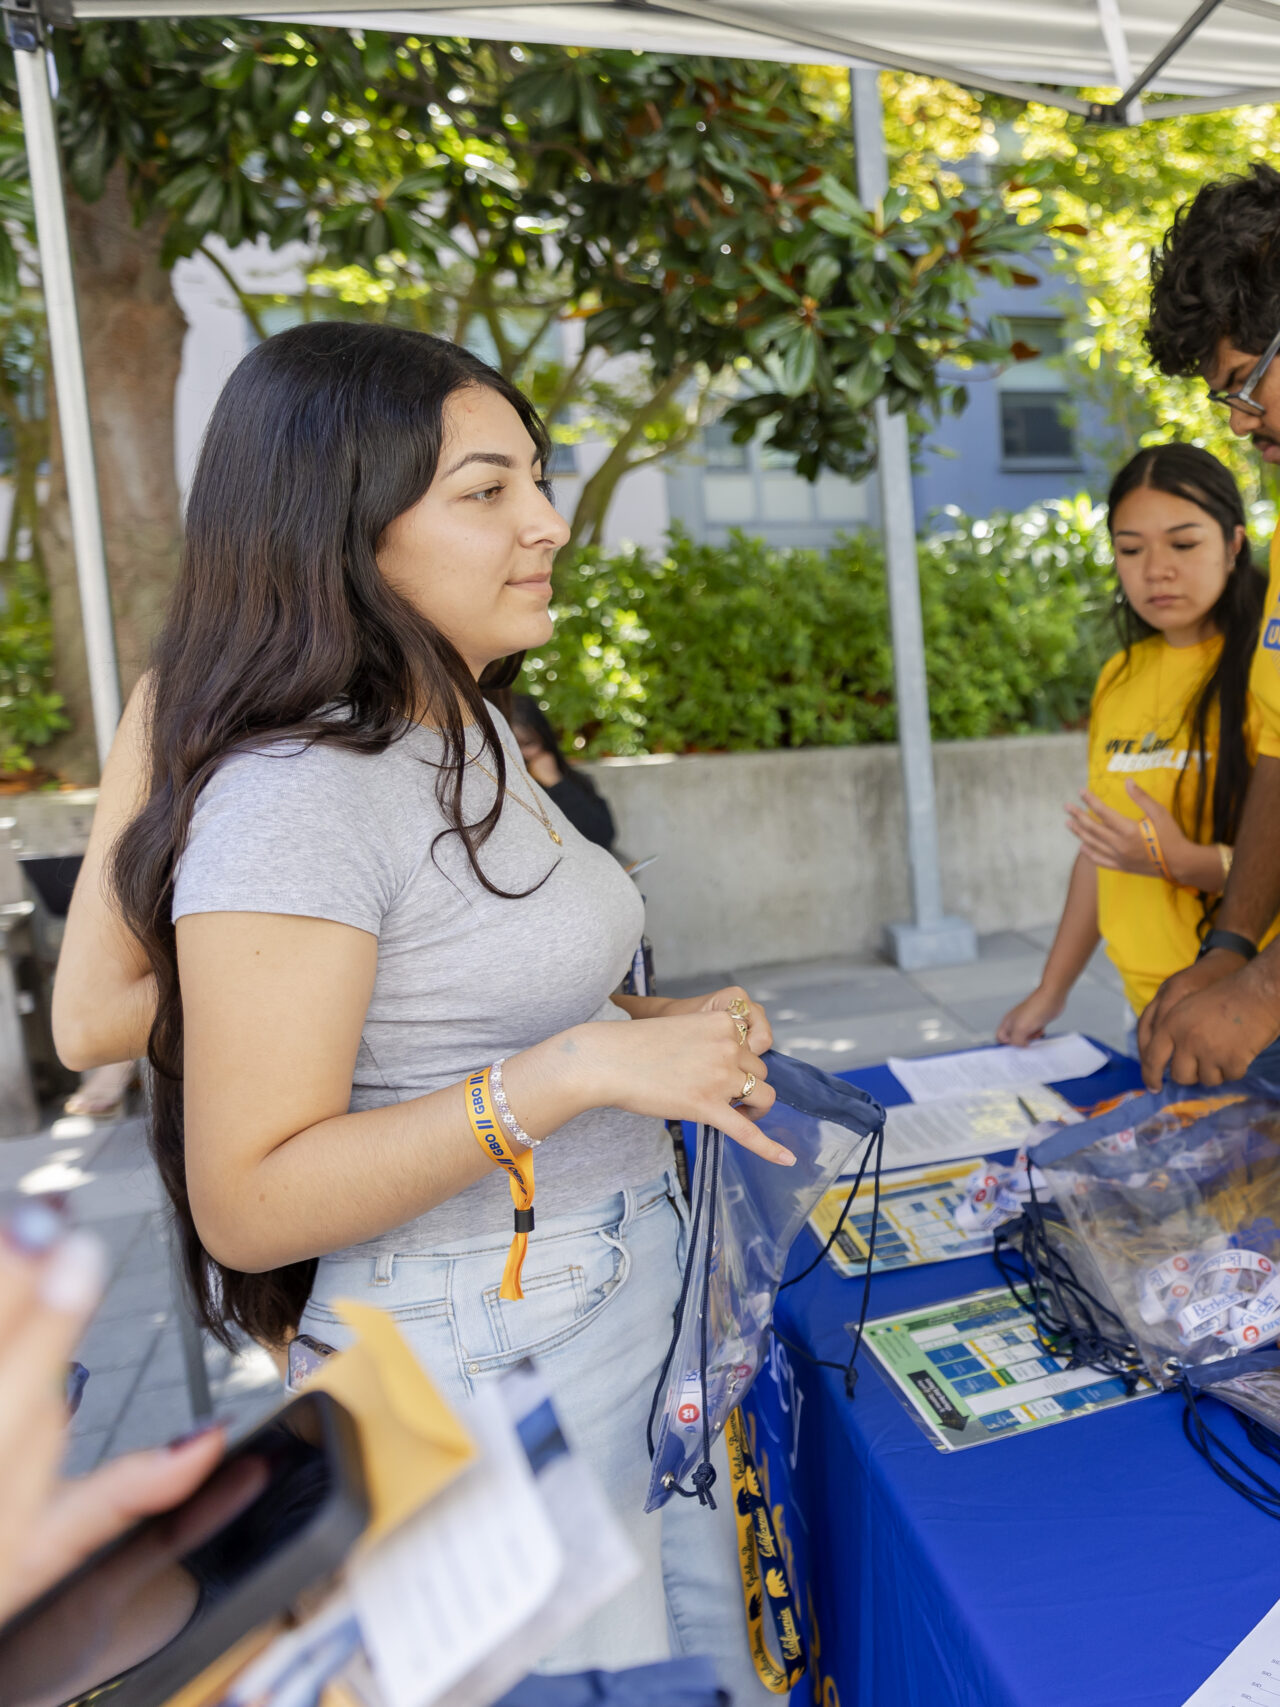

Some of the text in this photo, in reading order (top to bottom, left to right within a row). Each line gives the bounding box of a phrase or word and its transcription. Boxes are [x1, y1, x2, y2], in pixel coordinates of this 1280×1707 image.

[471, 1087, 485, 1115] GBO
[485, 1133, 504, 1157] GBO
[755, 1506, 777, 1557] California
[777, 1606, 802, 1660] California
